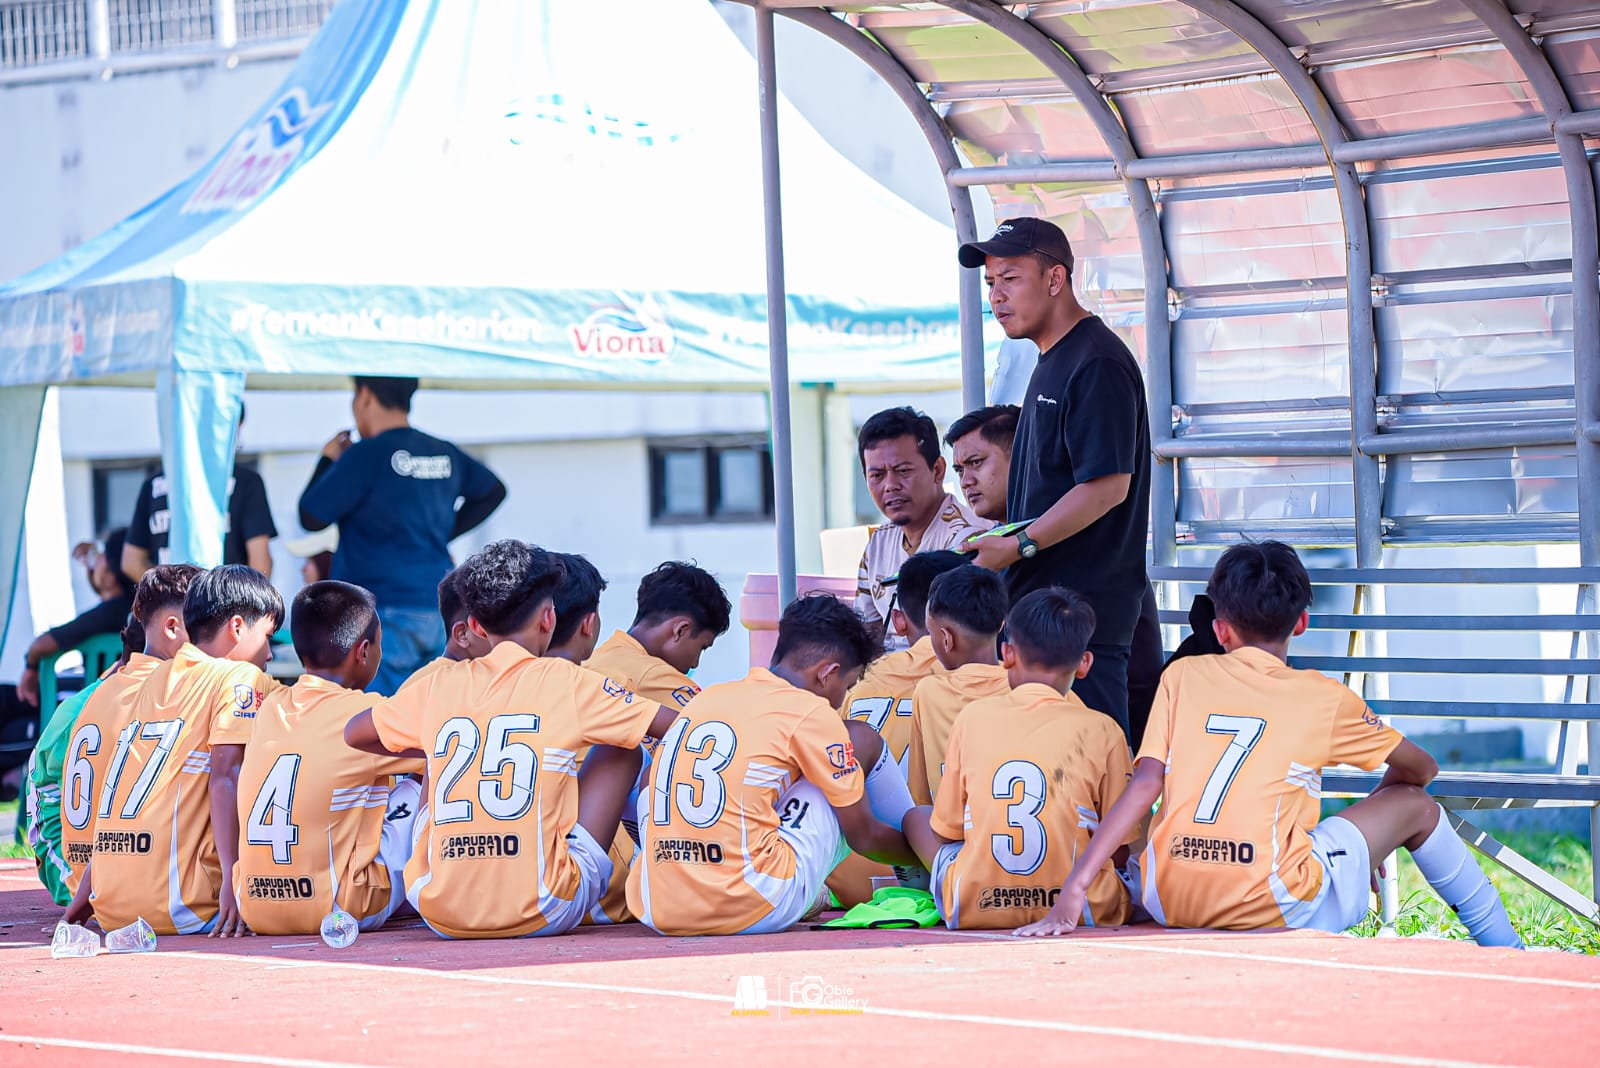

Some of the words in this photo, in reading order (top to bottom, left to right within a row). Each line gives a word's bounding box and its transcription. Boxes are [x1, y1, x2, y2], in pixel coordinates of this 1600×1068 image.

[572, 326, 666, 355] Viona
[64, 724, 101, 830] 6
[99, 718, 184, 820] 17
[434, 713, 540, 826] 25
[650, 717, 738, 829] 13
[1193, 713, 1267, 825] 7
[247, 753, 302, 865] 4
[991, 760, 1047, 876] 3
[98, 832, 130, 842] GARUDA
[98, 842, 130, 853] SPORT
[130, 832, 152, 853] 10
[447, 835, 495, 848] GARUDA
[494, 834, 519, 856] 10
[659, 840, 699, 852] GARUDA
[1182, 836, 1228, 851] GARUDA
[448, 845, 495, 858] SPORT
[662, 850, 699, 862] SPORT
[698, 842, 723, 863] 10
[1183, 848, 1228, 861] SPORT
[1228, 841, 1254, 864] 10
[254, 877, 291, 888] GARUDA
[255, 888, 292, 898] SPORT
[290, 877, 313, 898] 10
[993, 888, 1040, 899] GARUDA
[993, 898, 1040, 908] SPORT
